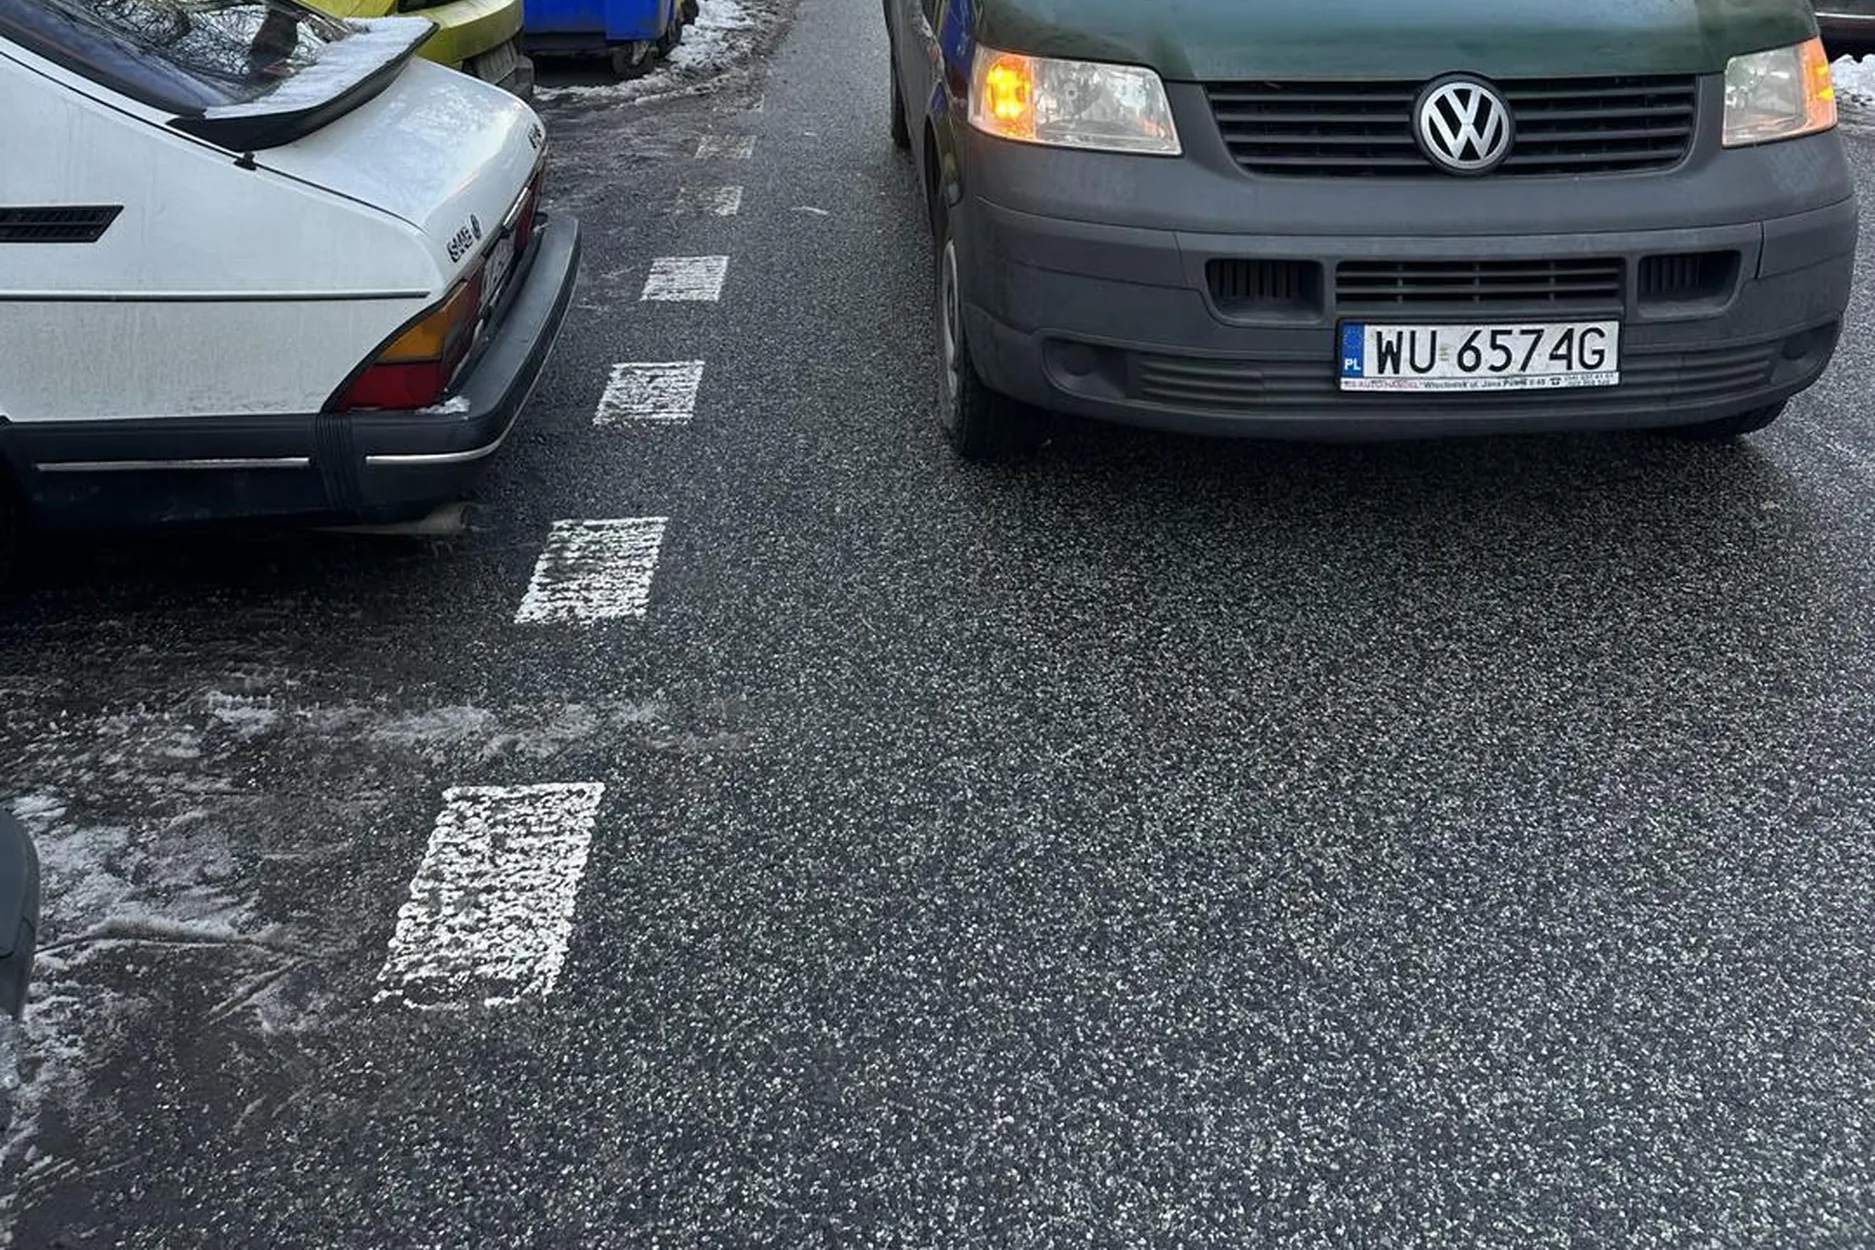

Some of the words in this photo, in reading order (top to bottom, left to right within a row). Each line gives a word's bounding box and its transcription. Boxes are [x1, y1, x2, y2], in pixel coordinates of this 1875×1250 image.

[1344, 358, 1361, 370] PL
[1376, 330, 1437, 374] WU
[1456, 327, 1606, 372] 6574G
